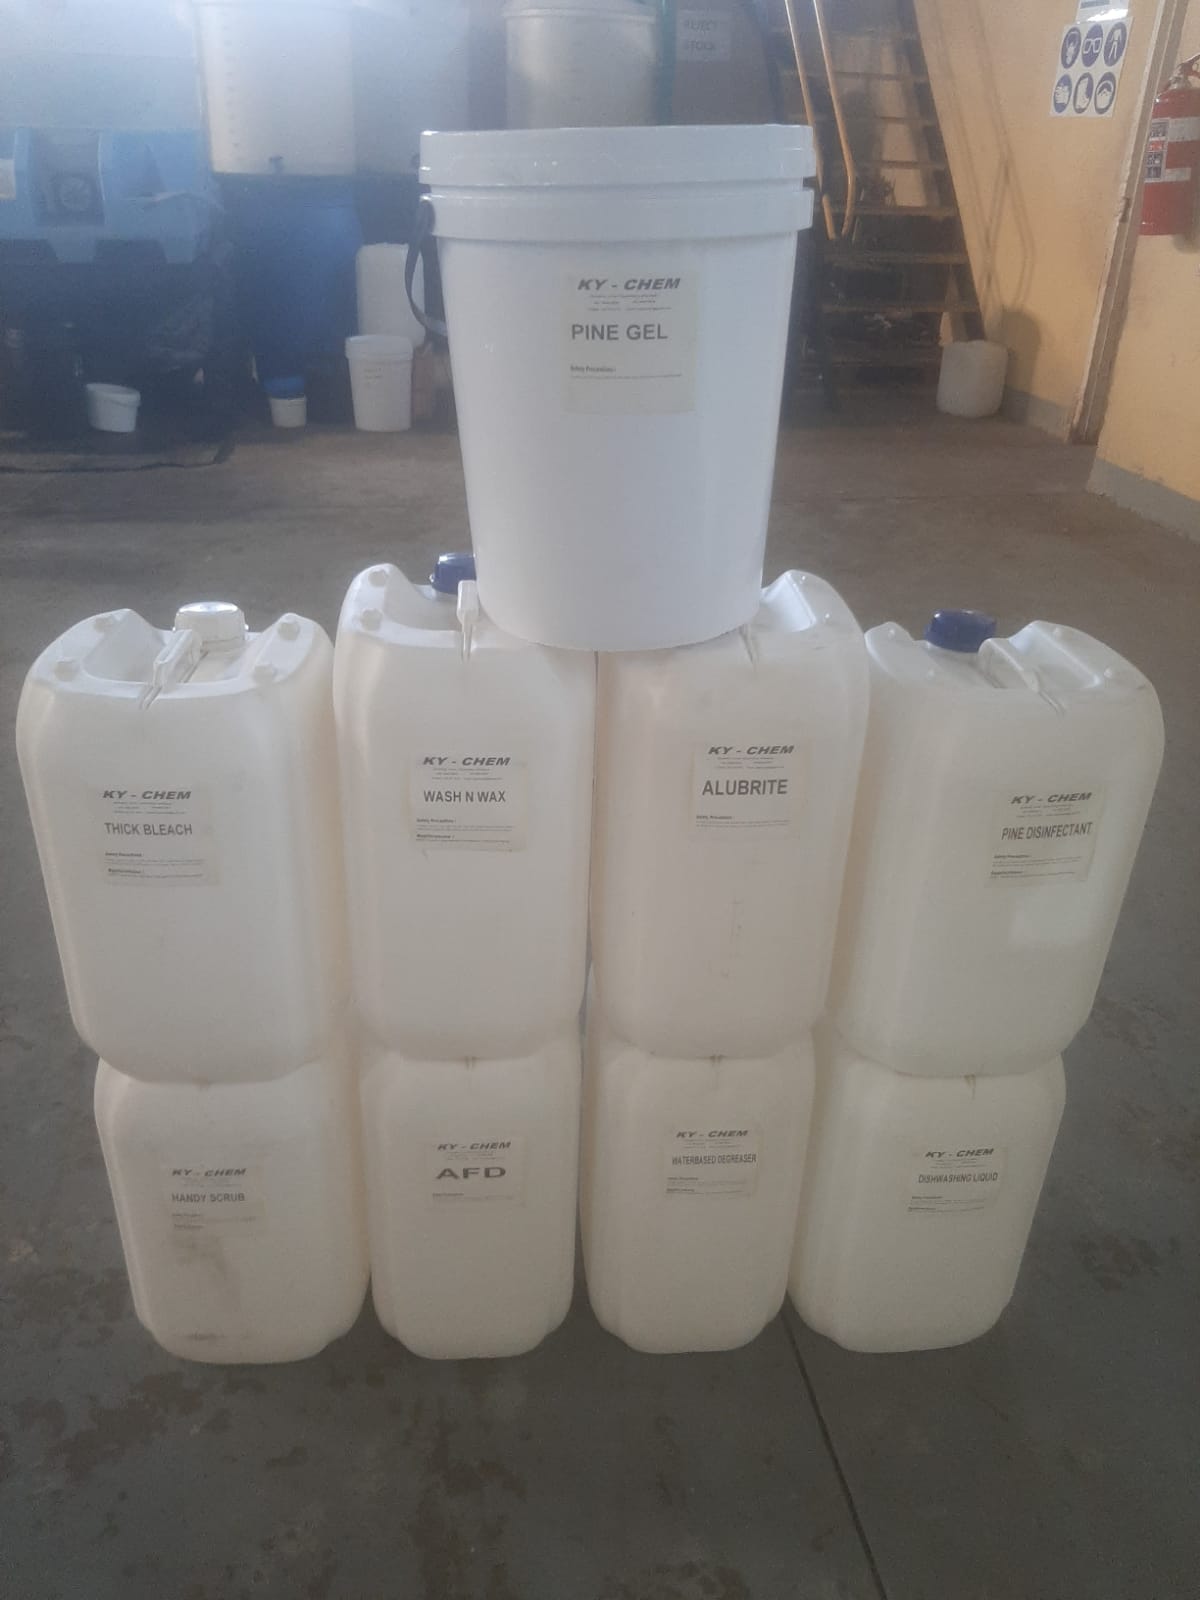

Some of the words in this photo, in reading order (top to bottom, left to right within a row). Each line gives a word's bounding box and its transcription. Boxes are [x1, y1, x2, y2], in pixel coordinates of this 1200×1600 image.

[577, 279, 608, 291] KY
[623, 278, 681, 290] CHEM
[571, 323, 619, 341] PINE
[626, 323, 668, 341] GEL
[708, 746, 733, 755] KY
[746, 745, 795, 755] CHEM
[422, 756, 448, 765] KY
[462, 757, 511, 766] CHEM
[702, 779, 789, 796] ALUBRITE
[102, 790, 128, 799] KY
[141, 790, 191, 800] CHEM
[423, 790, 462, 803] WASH
[465, 791, 474, 802] N
[477, 790, 506, 803] WAX
[1011, 795, 1035, 804] KY
[1047, 792, 1093, 803] CHEM
[104, 822, 140, 835] THICK
[143, 824, 193, 836] BLEACH
[1001, 827, 1024, 841] PINE
[1026, 821, 1093, 840] DISINFECTANT
[707, 1130, 748, 1138] CHEM
[437, 1143, 458, 1151] KY
[469, 1142, 511, 1150] CHEM
[956, 1148, 994, 1158] CHEM
[672, 1154, 716, 1166] WATERBASED
[717, 1153, 757, 1164] DEGREASER
[171, 1169, 193, 1177] KY
[204, 1168, 247, 1177] CHEM
[436, 1166, 506, 1180] AFD
[918, 1172, 972, 1184] DISHWASHING
[973, 1172, 998, 1182] LIQUID
[171, 1193, 207, 1203] HANDY
[209, 1192, 245, 1202] SCRUB
